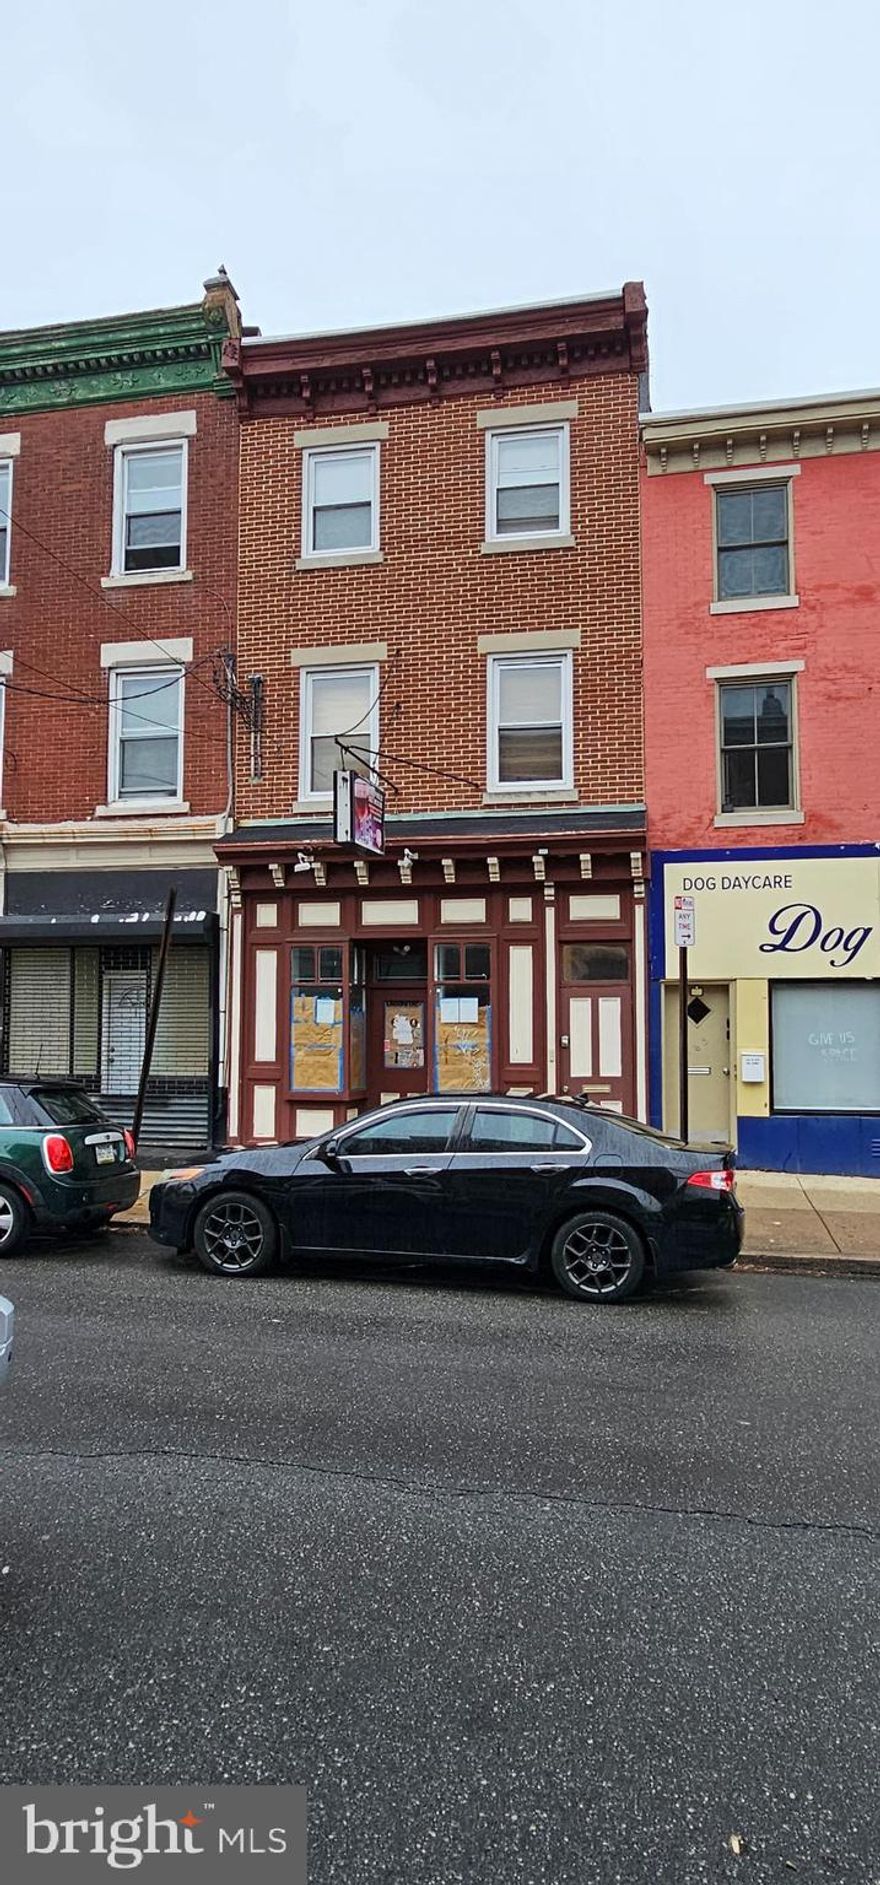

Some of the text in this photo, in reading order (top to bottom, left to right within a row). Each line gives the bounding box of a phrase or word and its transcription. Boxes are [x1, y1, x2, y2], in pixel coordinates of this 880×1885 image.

[683, 875, 792, 891] DOG DAYCARE
[678, 913, 691, 921] ANY
[678, 923, 691, 931] TIME
[759, 903, 873, 967] Dog
[839, 1031, 856, 1044] US
